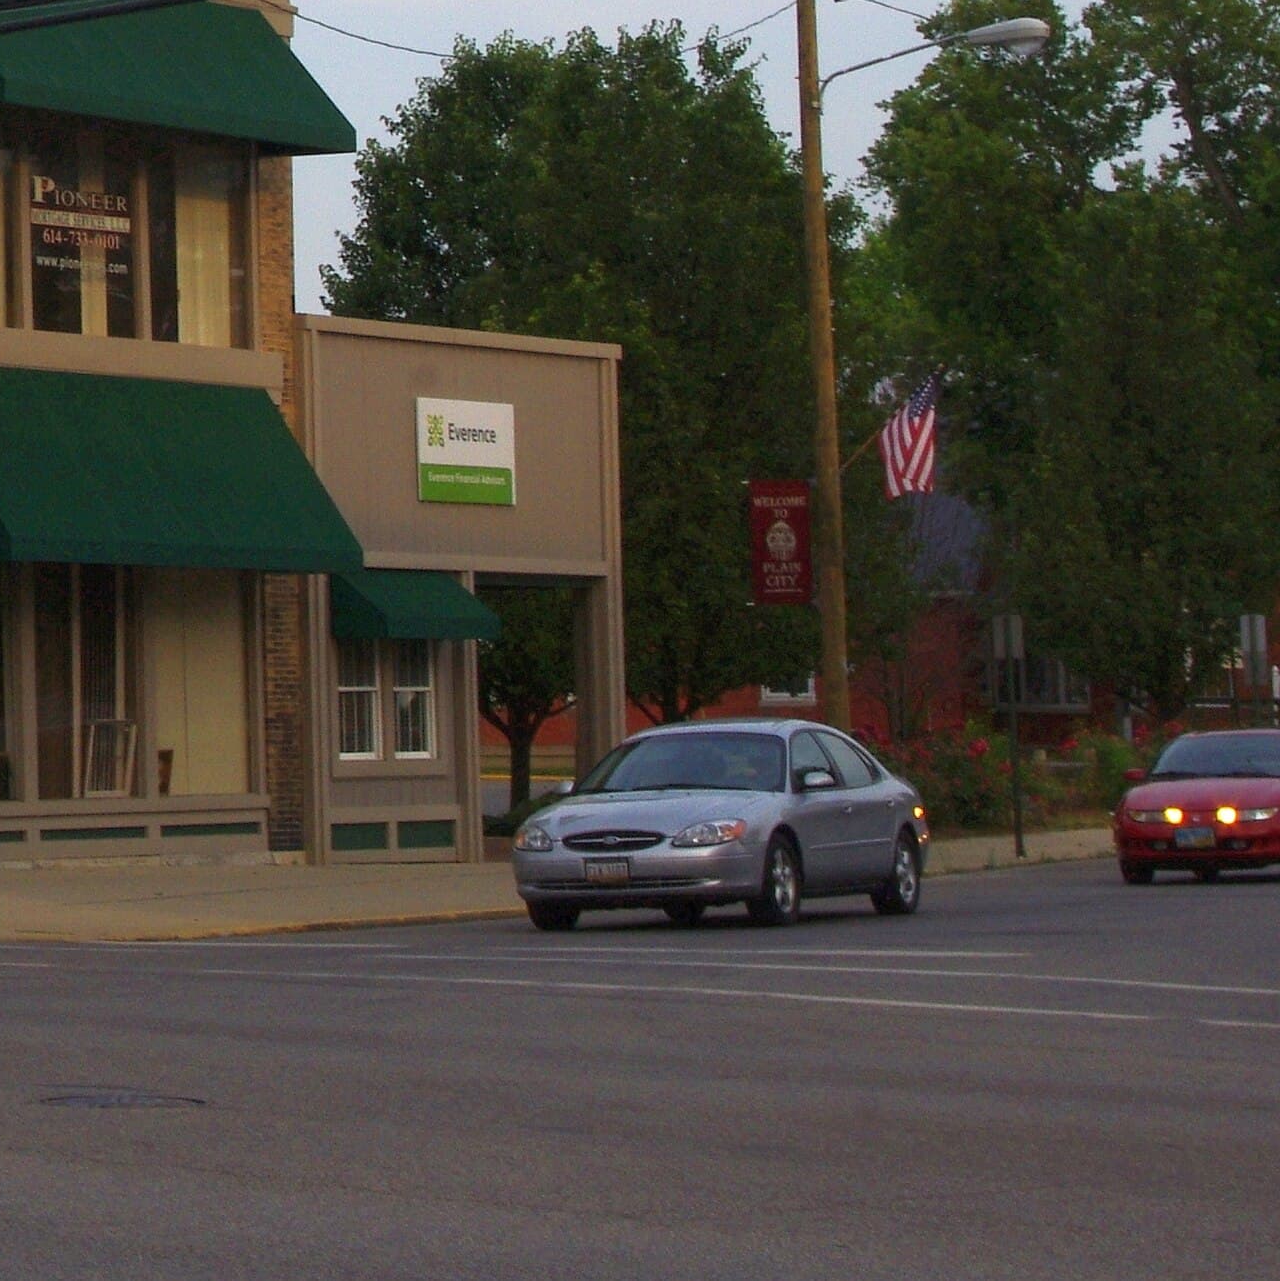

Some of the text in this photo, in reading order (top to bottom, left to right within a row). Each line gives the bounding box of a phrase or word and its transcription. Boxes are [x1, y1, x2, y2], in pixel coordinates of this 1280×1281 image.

[43, 229, 120, 249] 614-733-0101
[448, 423, 497, 444] Everence
[456, 473, 480, 484] Financial
[753, 495, 807, 507] WELCOME
[774, 509, 788, 519] TO
[763, 562, 801, 574] PLAIN
[765, 575, 798, 587] CITY
